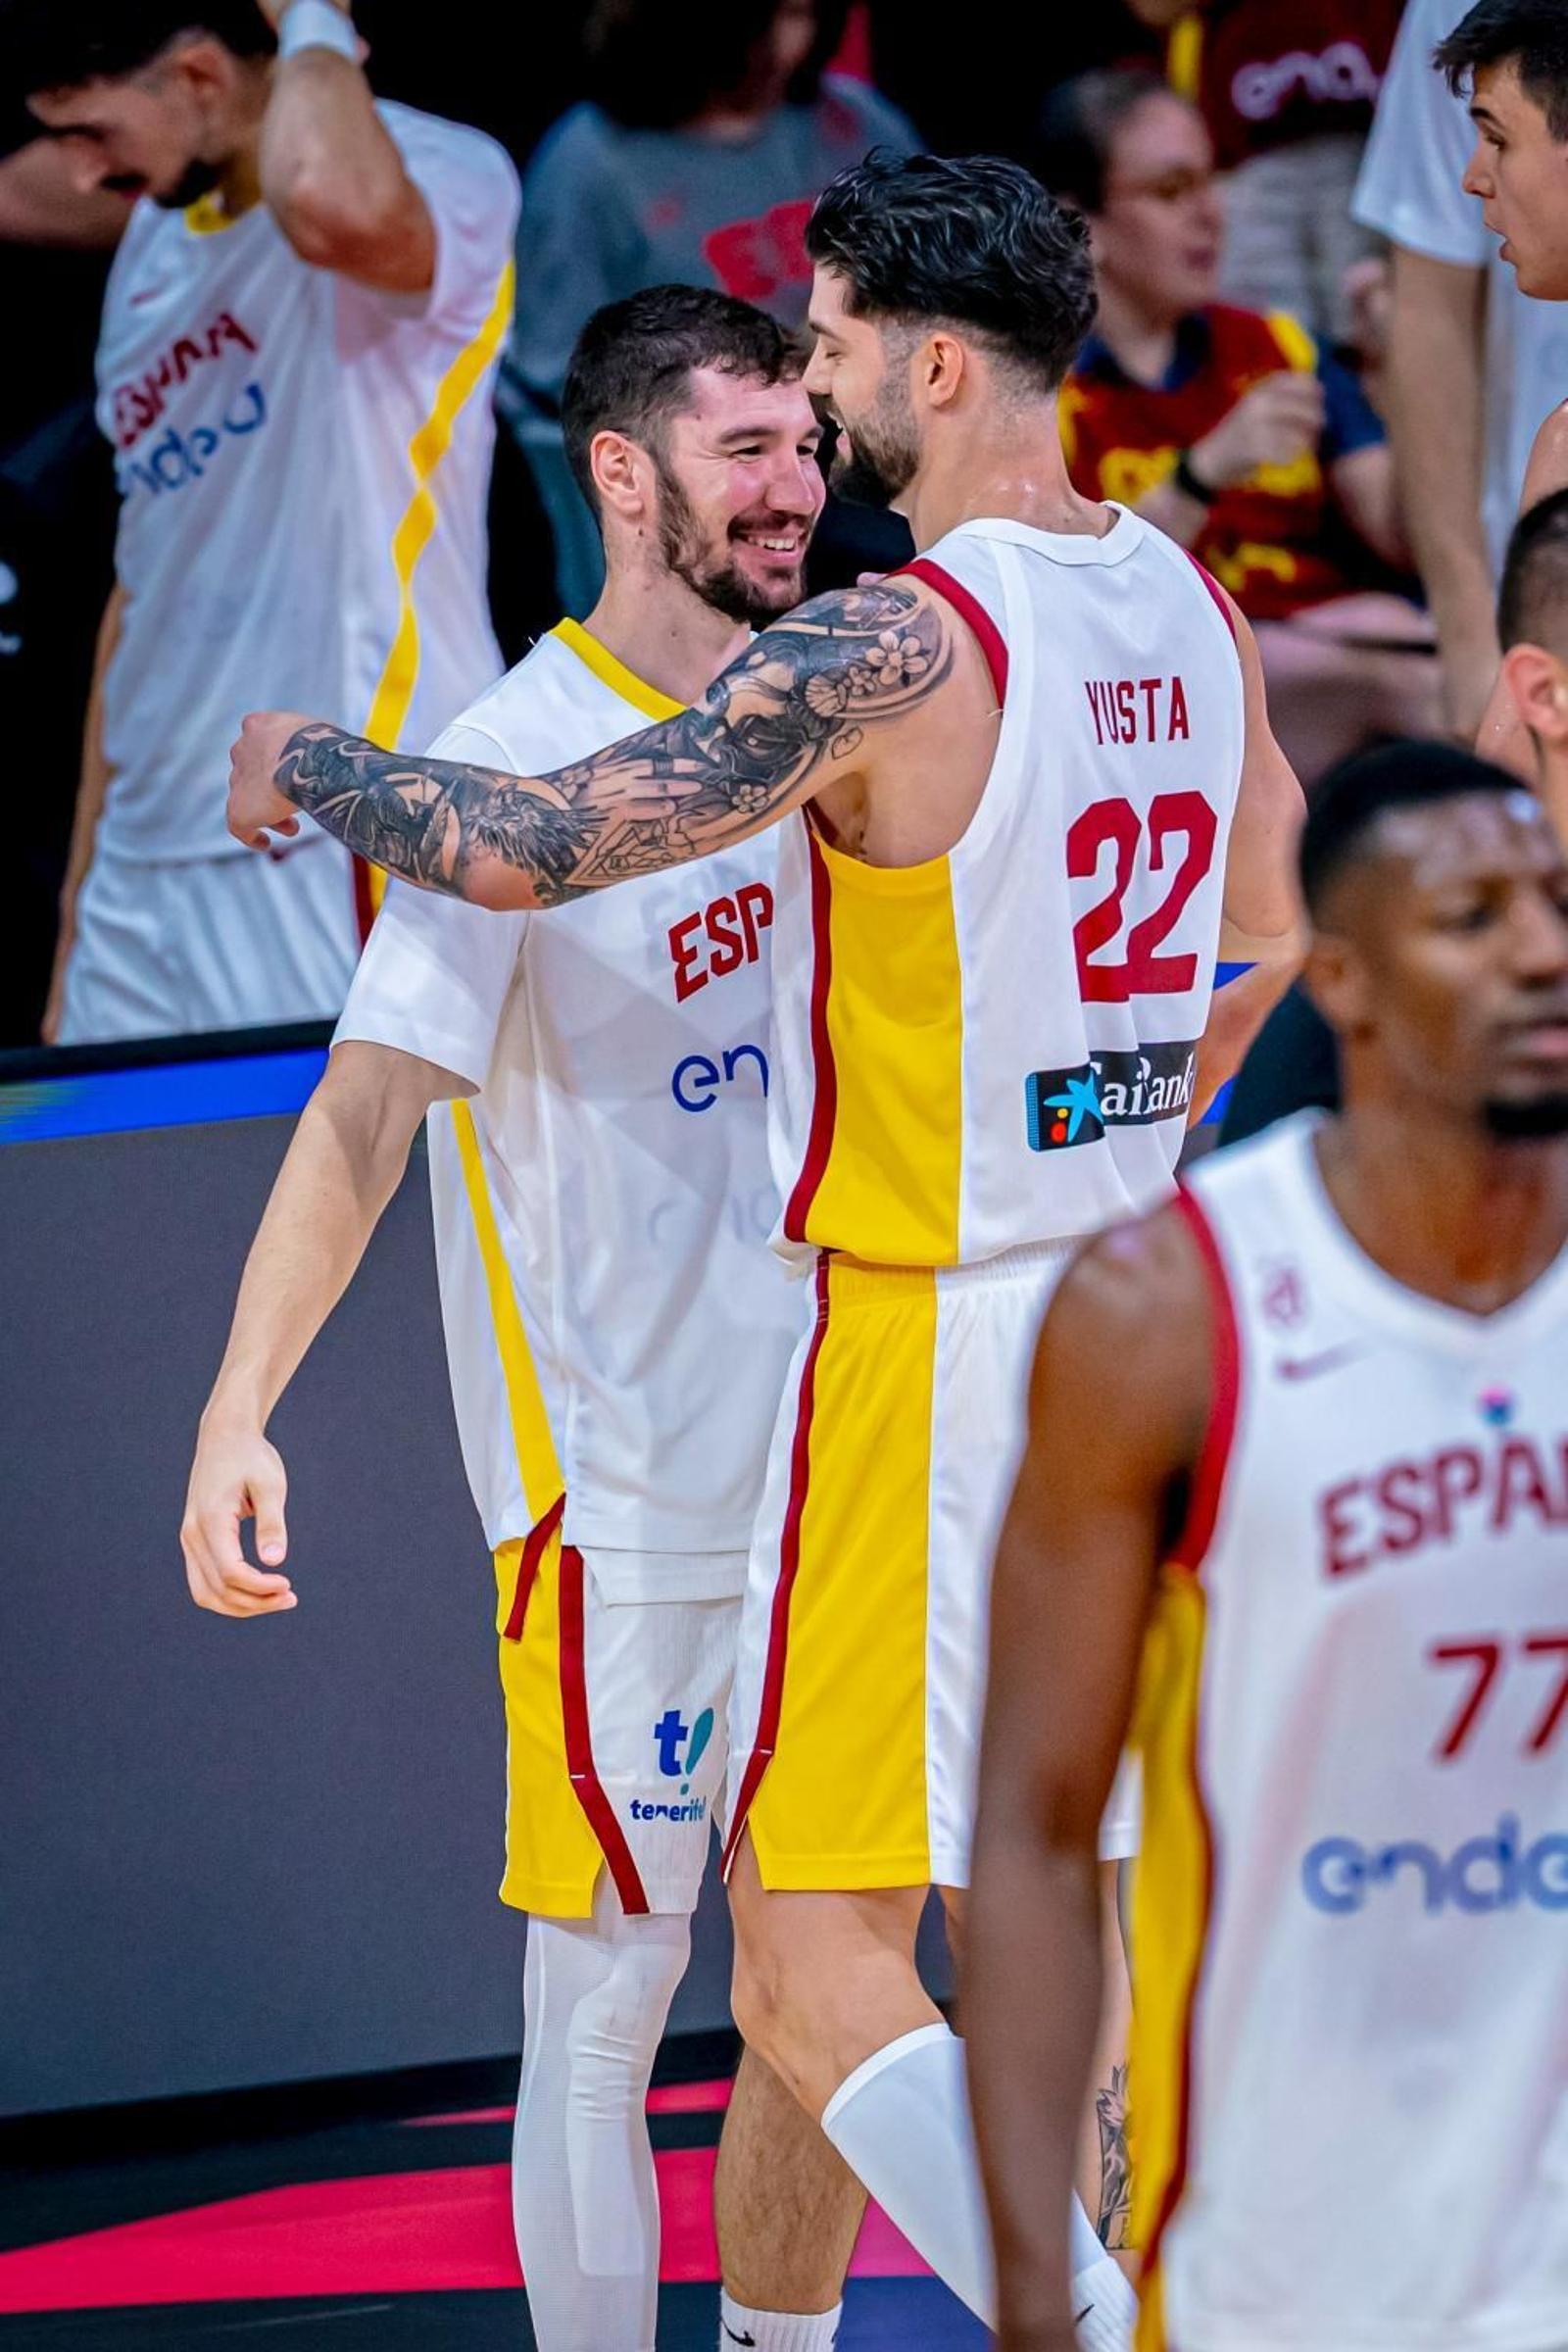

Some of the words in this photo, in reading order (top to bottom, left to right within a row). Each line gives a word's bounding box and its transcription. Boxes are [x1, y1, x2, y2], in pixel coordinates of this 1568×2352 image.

[1084, 676, 1190, 745] YUSTA
[1066, 790, 1219, 1004] 22
[1319, 1438, 1568, 1580] ESPA
[1427, 1640, 1568, 1764] 77
